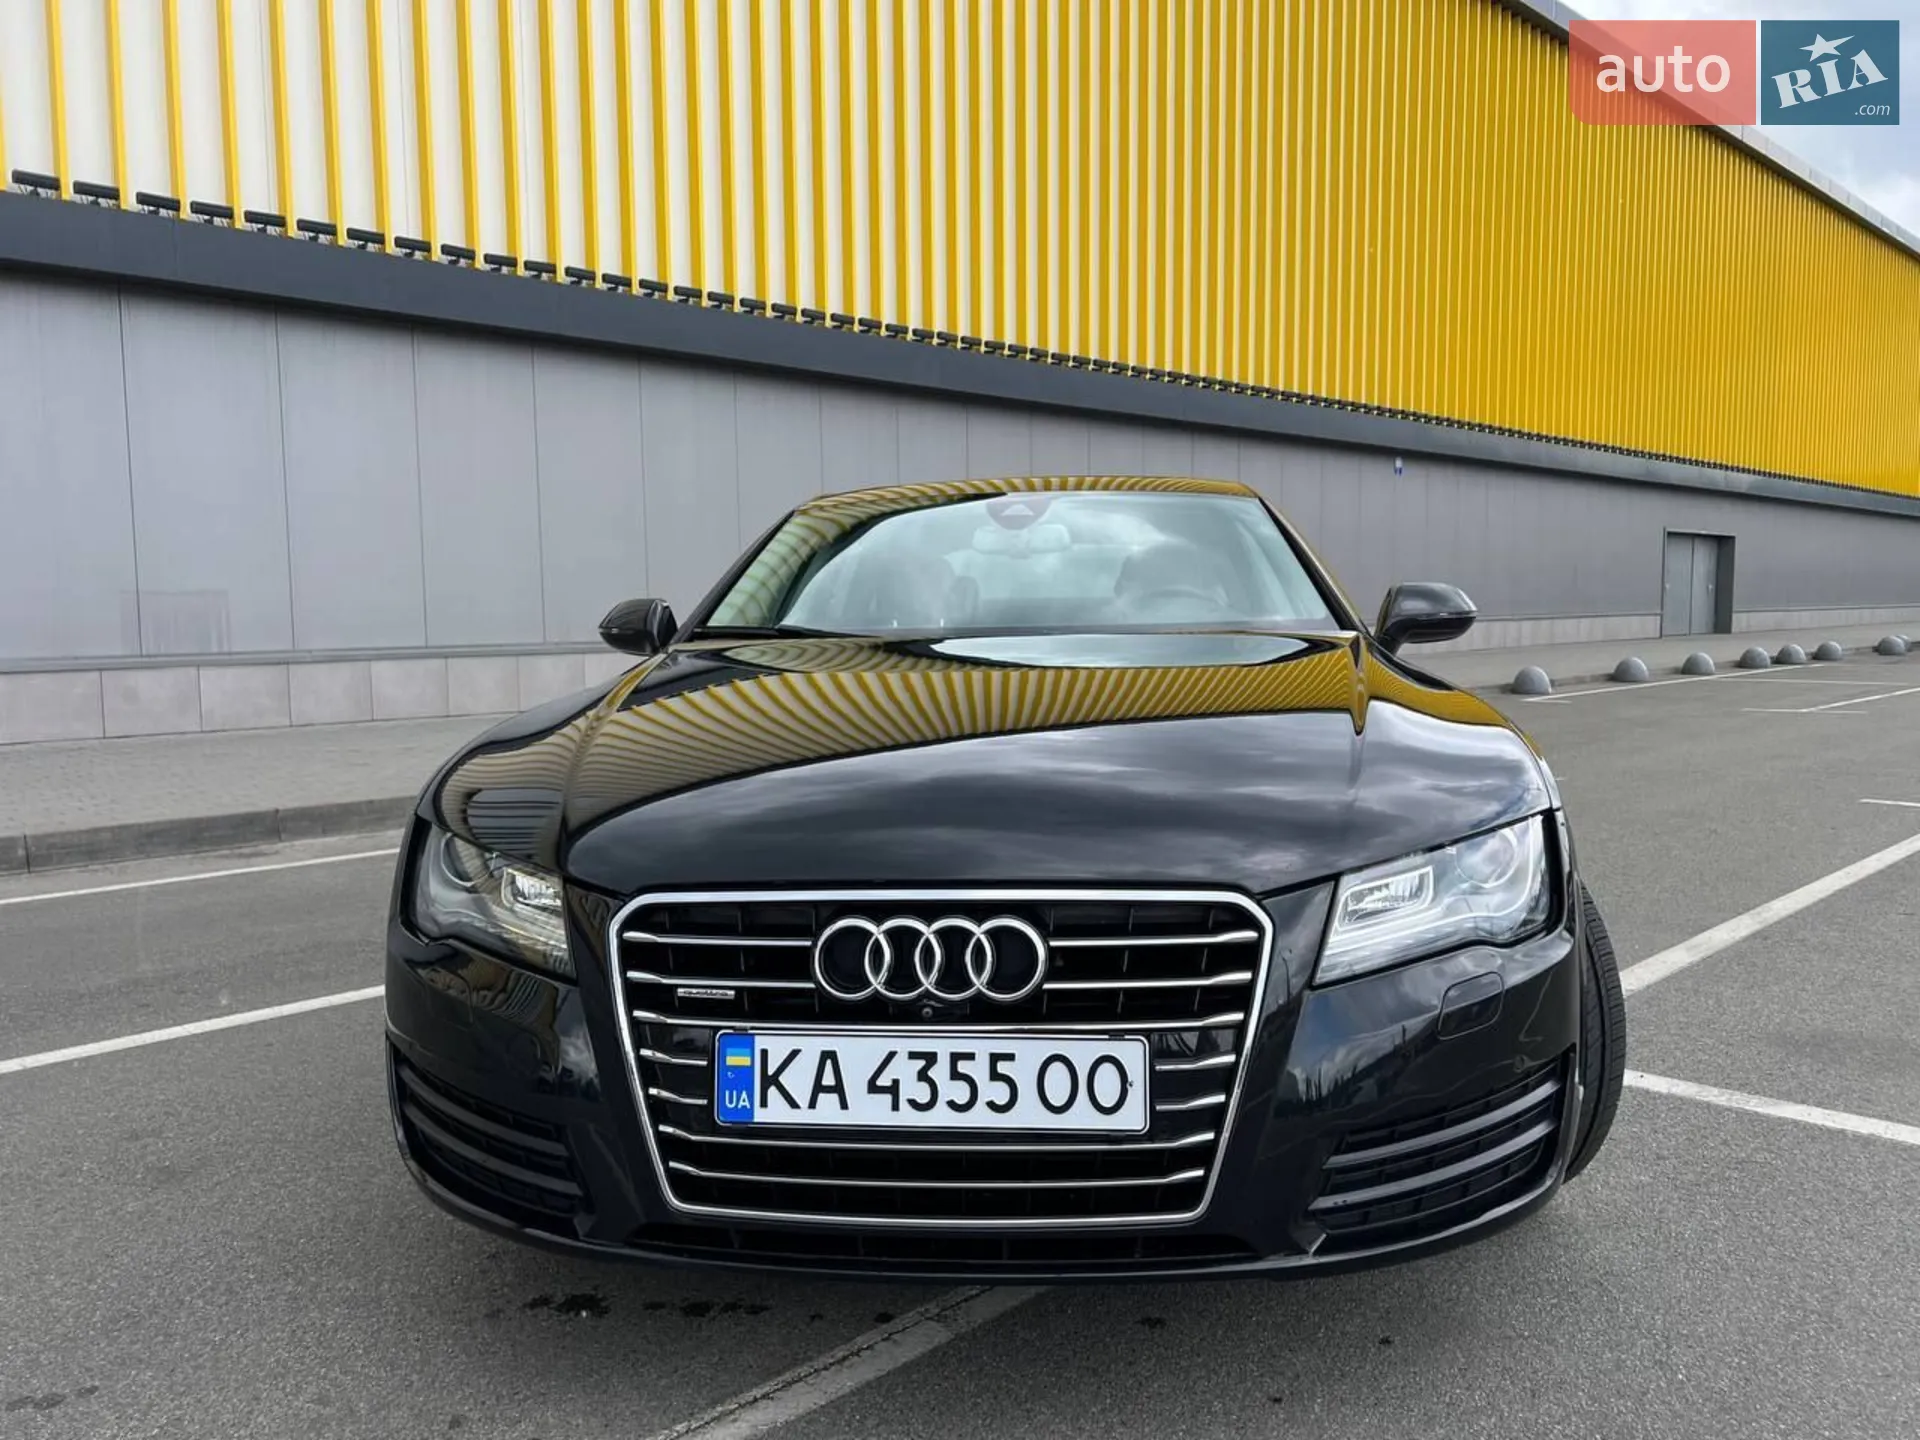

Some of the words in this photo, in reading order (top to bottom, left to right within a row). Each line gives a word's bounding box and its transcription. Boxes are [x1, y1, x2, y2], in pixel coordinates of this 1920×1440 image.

[725, 1090, 751, 1110] UA
[759, 1048, 850, 1111] KA
[866, 1050, 1019, 1114] 4355
[1036, 1053, 1130, 1116] OO
